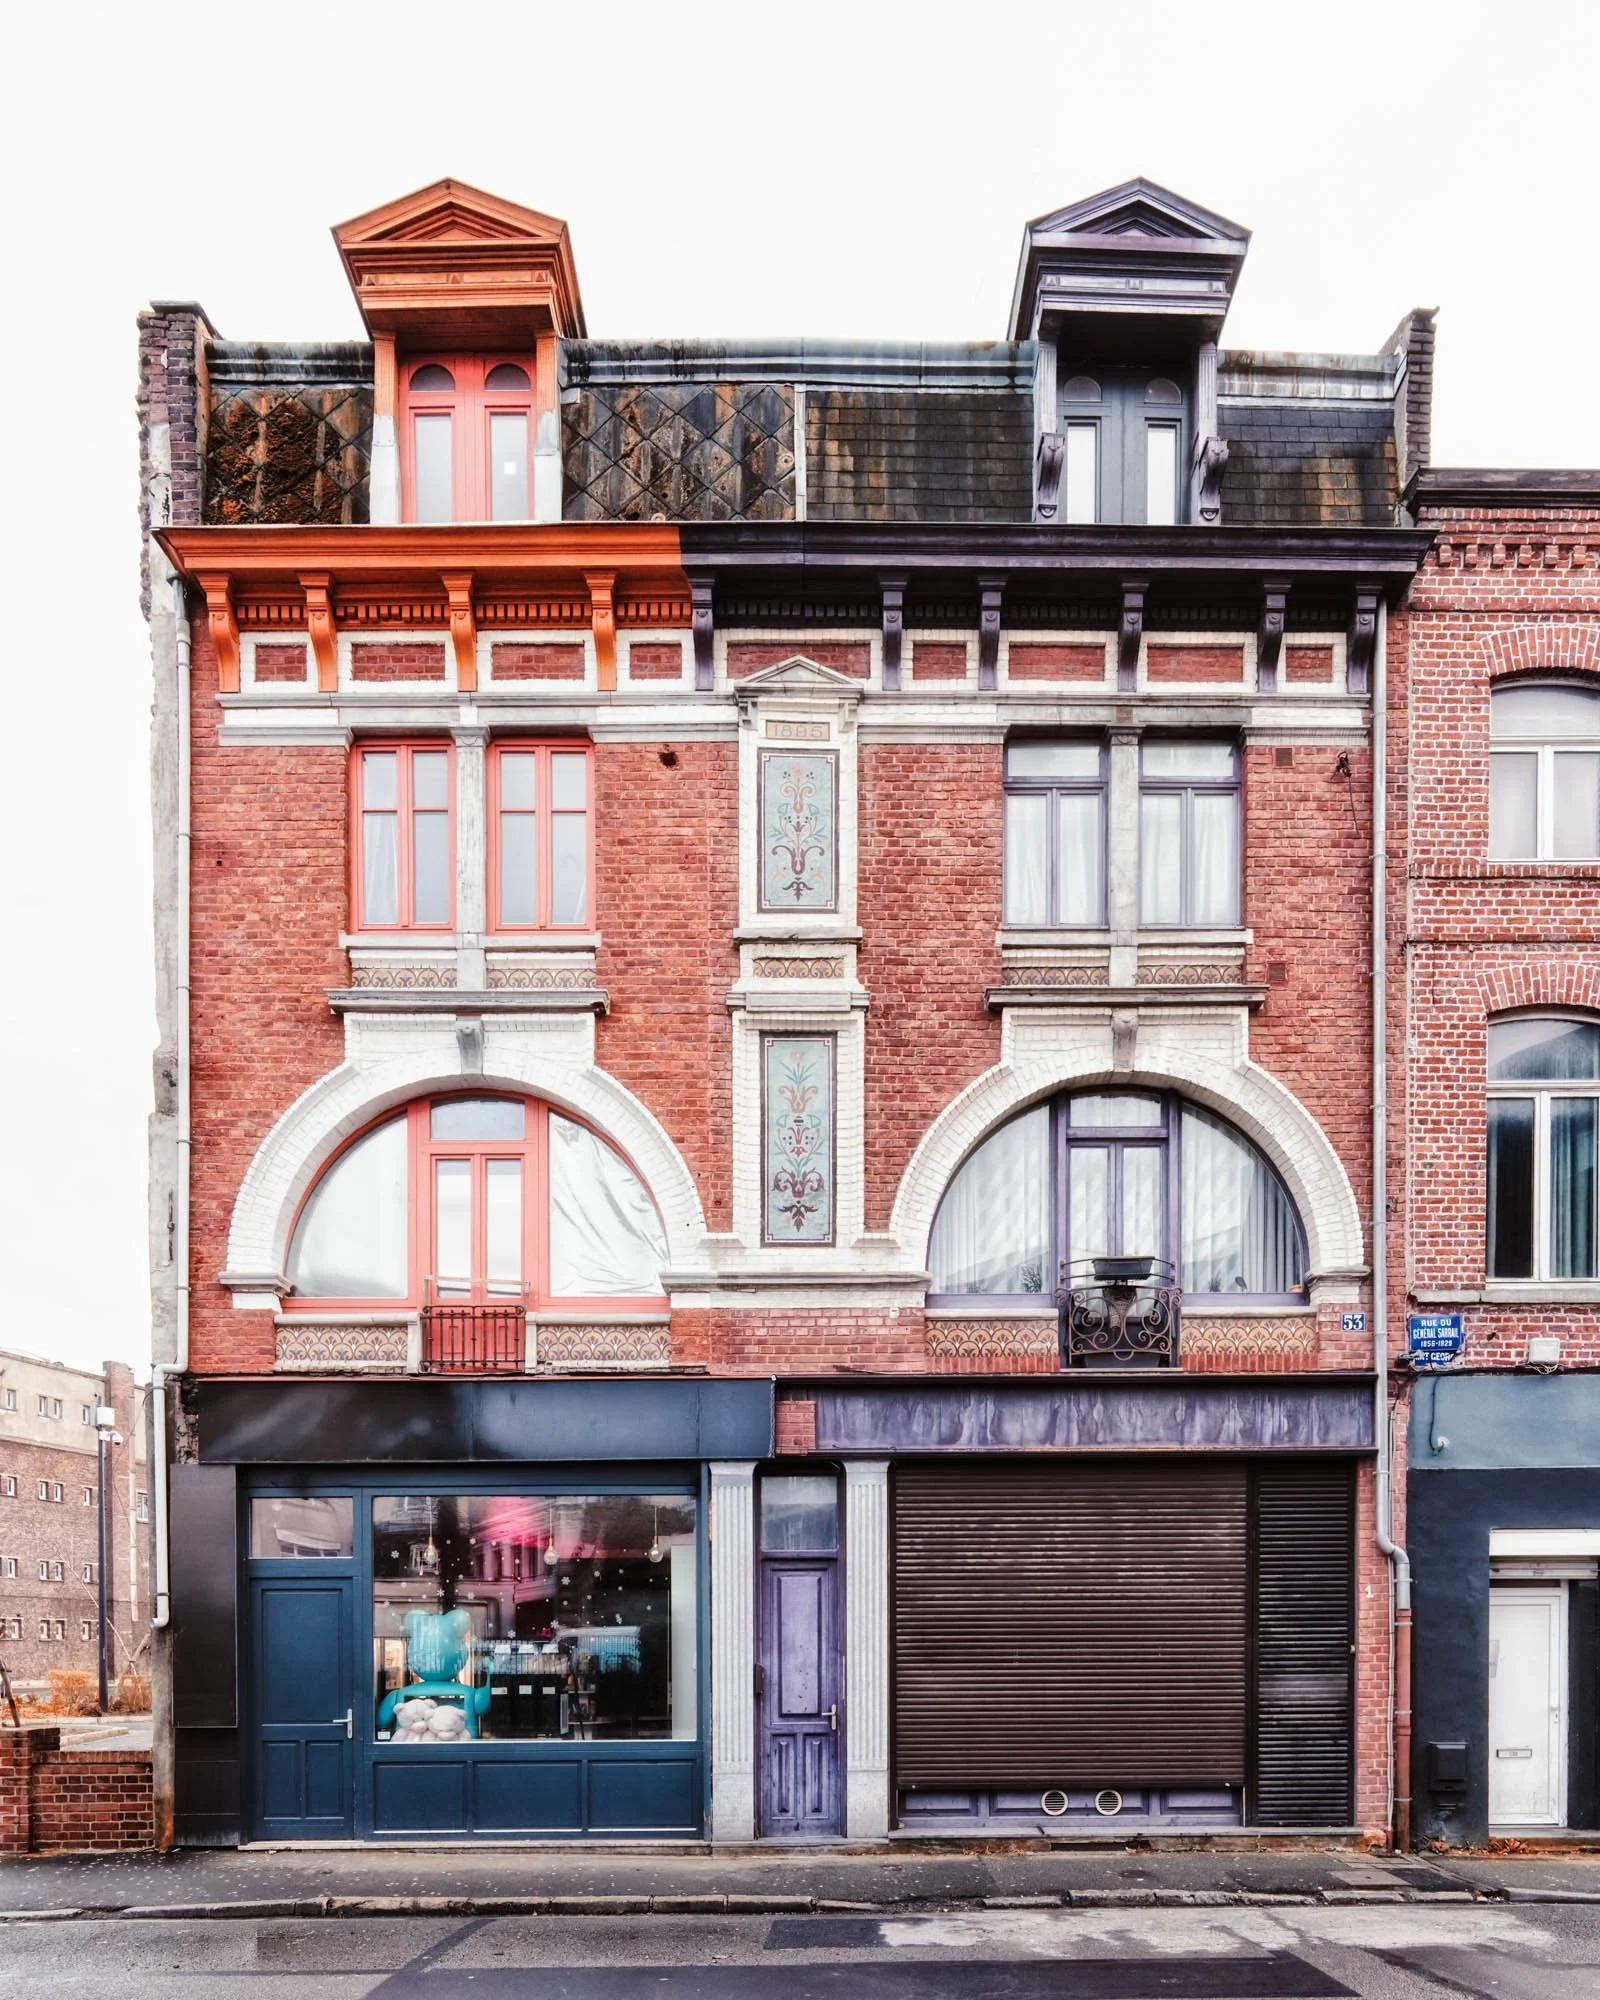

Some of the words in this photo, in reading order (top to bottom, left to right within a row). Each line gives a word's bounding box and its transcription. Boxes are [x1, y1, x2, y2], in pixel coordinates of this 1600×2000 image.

[1343, 1314, 1362, 1330] 53
[1421, 1319, 1438, 1327] RUE
[1440, 1319, 1451, 1327] DU
[1438, 1327, 1459, 1338] SARRAIL
[1364, 1585, 1374, 1599] 1
